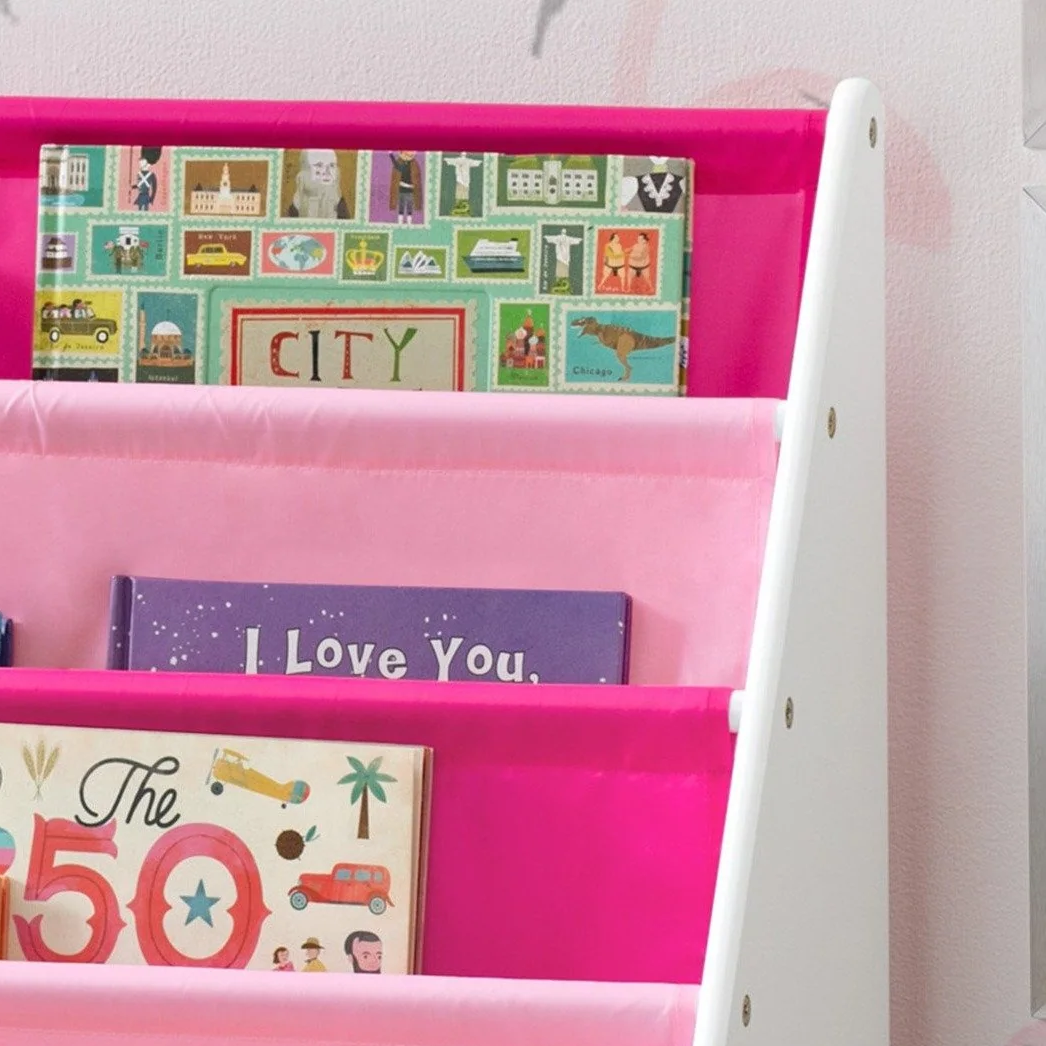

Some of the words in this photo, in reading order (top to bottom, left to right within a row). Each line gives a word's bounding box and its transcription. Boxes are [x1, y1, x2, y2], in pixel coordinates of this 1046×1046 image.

[270, 327, 418, 382] CITY
[572, 366, 614, 377] Chicago
[245, 627, 260, 675] I
[285, 628, 407, 680] Love
[74, 755, 181, 829] The
[12, 812, 273, 970] 50
